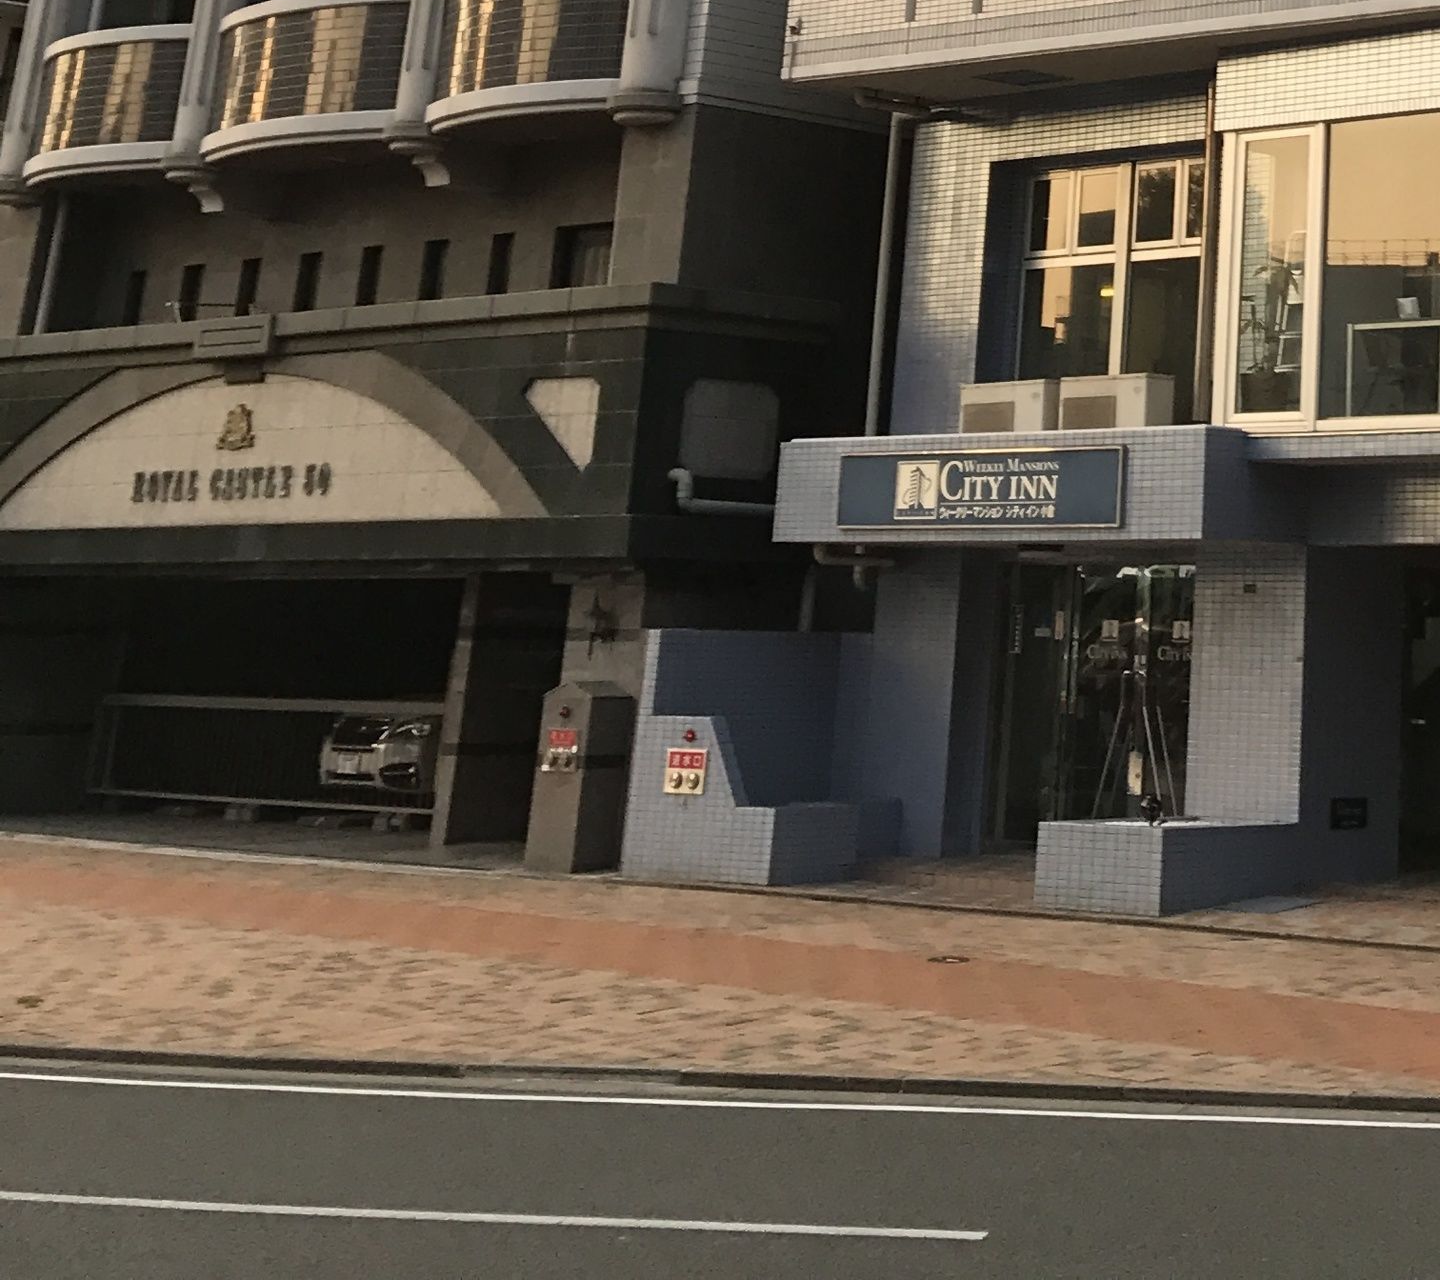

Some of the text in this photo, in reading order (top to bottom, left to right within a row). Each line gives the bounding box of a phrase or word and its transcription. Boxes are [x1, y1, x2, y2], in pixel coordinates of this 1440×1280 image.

[131, 470, 199, 503] ROYAL
[209, 466, 293, 501] CASTLE
[940, 460, 1059, 501] CITY INN
